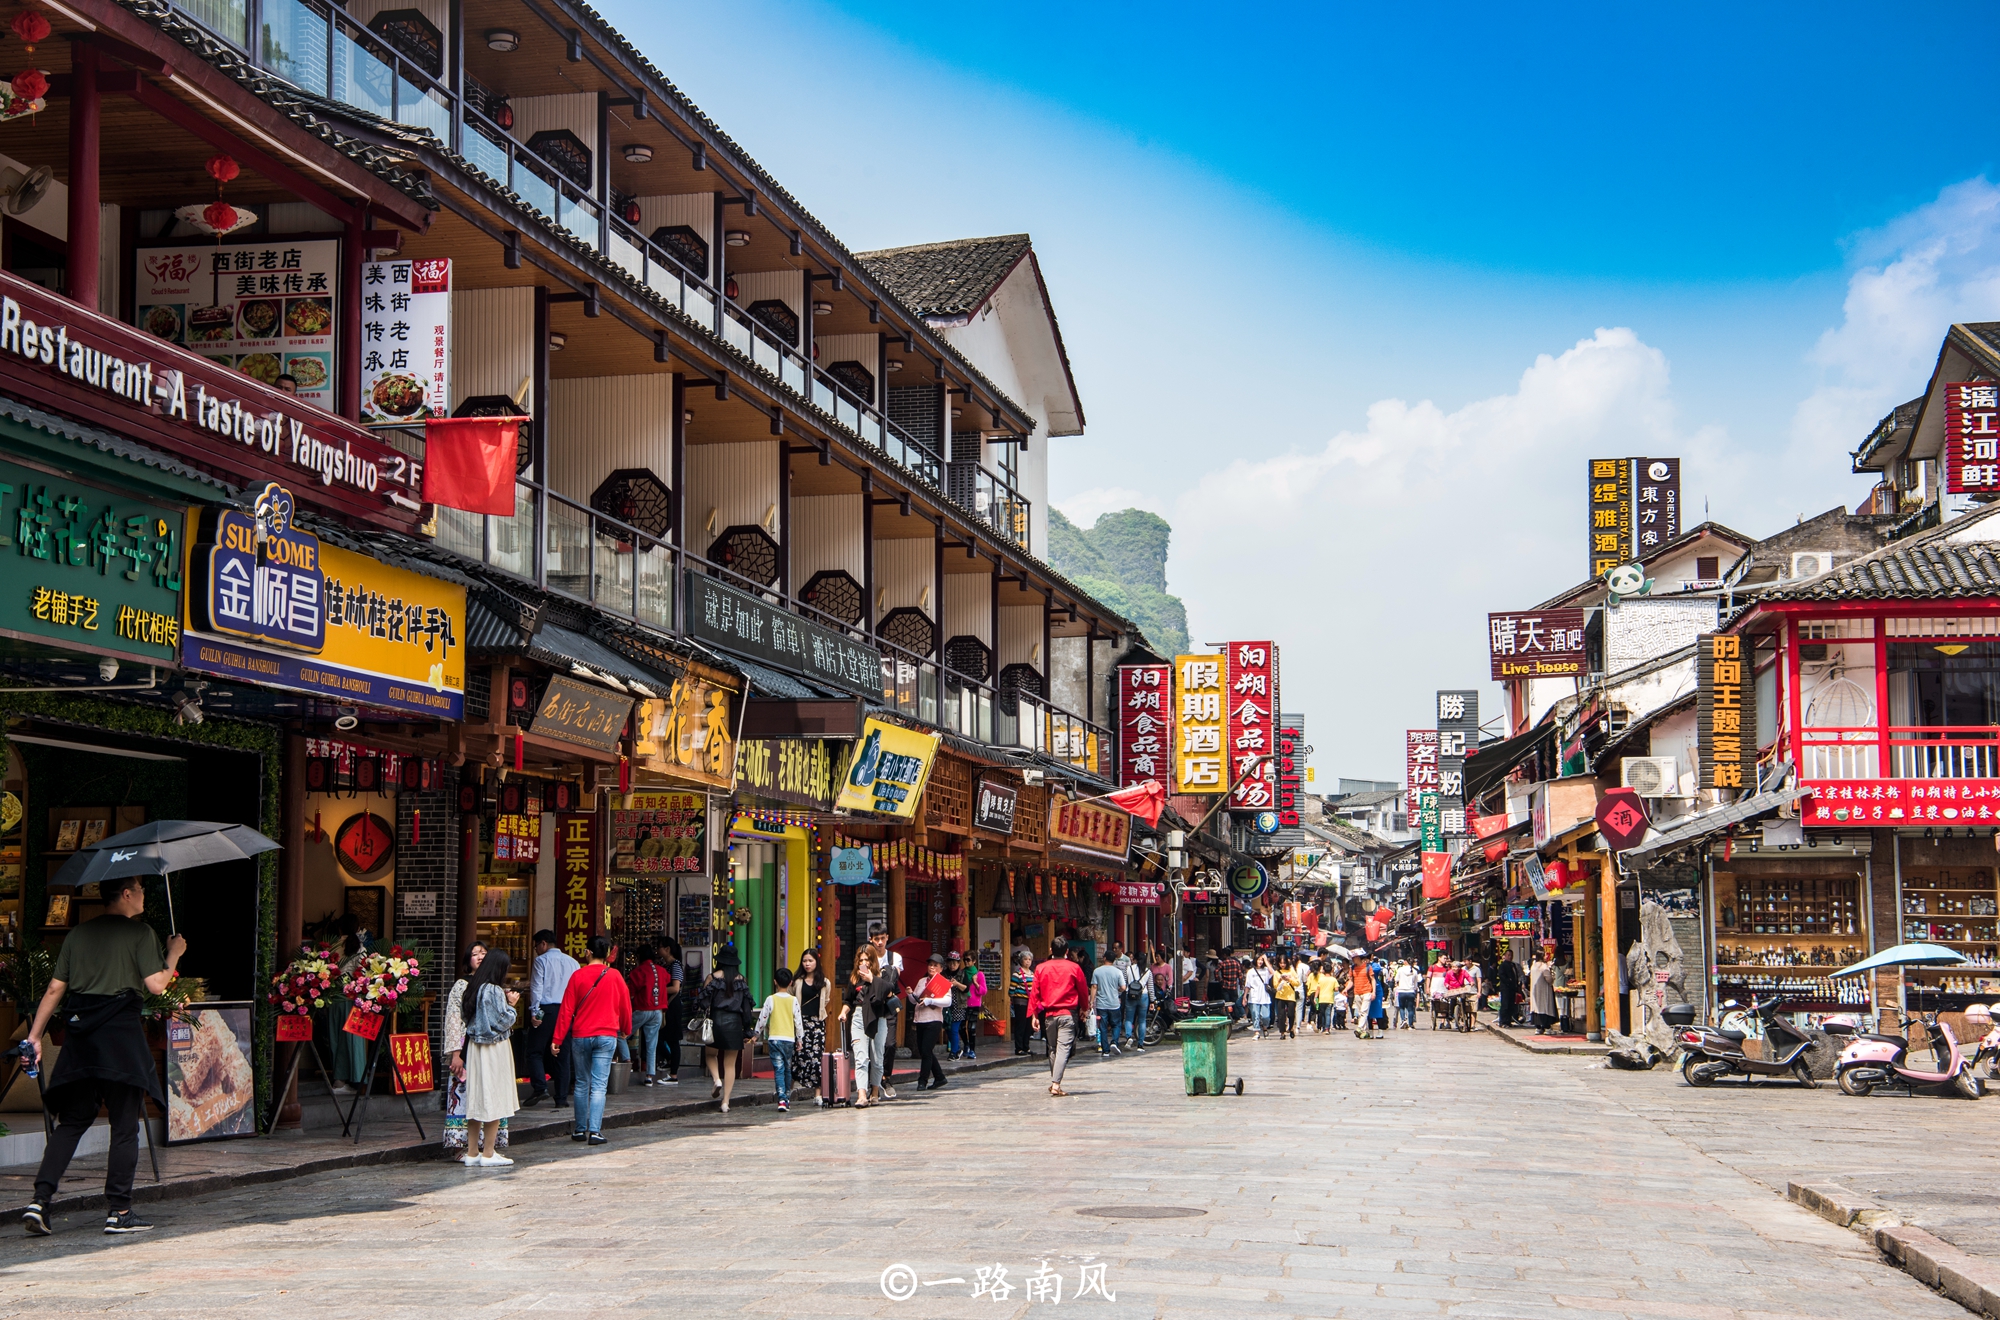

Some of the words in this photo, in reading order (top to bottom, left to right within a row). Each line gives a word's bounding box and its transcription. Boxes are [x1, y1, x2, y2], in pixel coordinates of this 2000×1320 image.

[211, 248, 302, 271] 西街老店
[236, 272, 328, 296] 美味传承
[364, 264, 386, 372] 美味传承
[390, 263, 411, 369] 西街老店
[433, 325, 445, 369] 观景餐厅
[433, 371, 445, 417] 请上二楼
[197, 384, 255, 446] taste
[261, 411, 283, 456] of
[289, 417, 379, 493] Yangshuo
[1959, 386, 1998, 486] 漓江河鲜
[1593, 460, 1618, 576] 香缇雅酒店
[1639, 486, 1659, 553] 東方客
[1666, 489, 1675, 538] ORIENTAL
[32, 586, 99, 630] 老铺手艺
[117, 604, 179, 647] 代代相传
[219, 557, 319, 637] 金顺昌
[324, 576, 456, 660] 桂林桂花伴手礼
[1491, 616, 1545, 655] 晴天
[1551, 628, 1583, 652] 酒吧
[200, 646, 222, 664] GUILIN
[223, 651, 246, 668] GUIHUA
[248, 656, 281, 675] BANSHOULI
[300, 667, 320, 684] GUILIN
[321, 672, 342, 688] GUIHUA
[342, 676, 372, 695] BANSHOULI
[1502, 663, 1530, 675] Live
[1536, 661, 1579, 673] house
[388, 686, 406, 700] GUILIN
[407, 690, 425, 704] GUIHUA
[1712, 635, 1742, 788] 时间主题客栈
[1182, 661, 1221, 785] 假期酒店
[1231, 645, 1270, 807] 阳朔食品商场
[1280, 727, 1300, 825] feeling
[1439, 694, 1466, 835] 勝記粉庫
[1811, 786, 1901, 800] 正宗桂林米粉
[1816, 806, 1831, 820] 粥
[1911, 807, 1941, 820] 豆浆
[1962, 805, 1993, 820] 油条
[615, 810, 696, 824] 真正正宗特产
[615, 826, 697, 839] 不看广告看实料
[1614, 810, 1633, 827] 酒
[478, 876, 508, 887] 花香水
[634, 855, 699, 872] 全场免费吃
[564, 819, 590, 969] 正宗名优特
